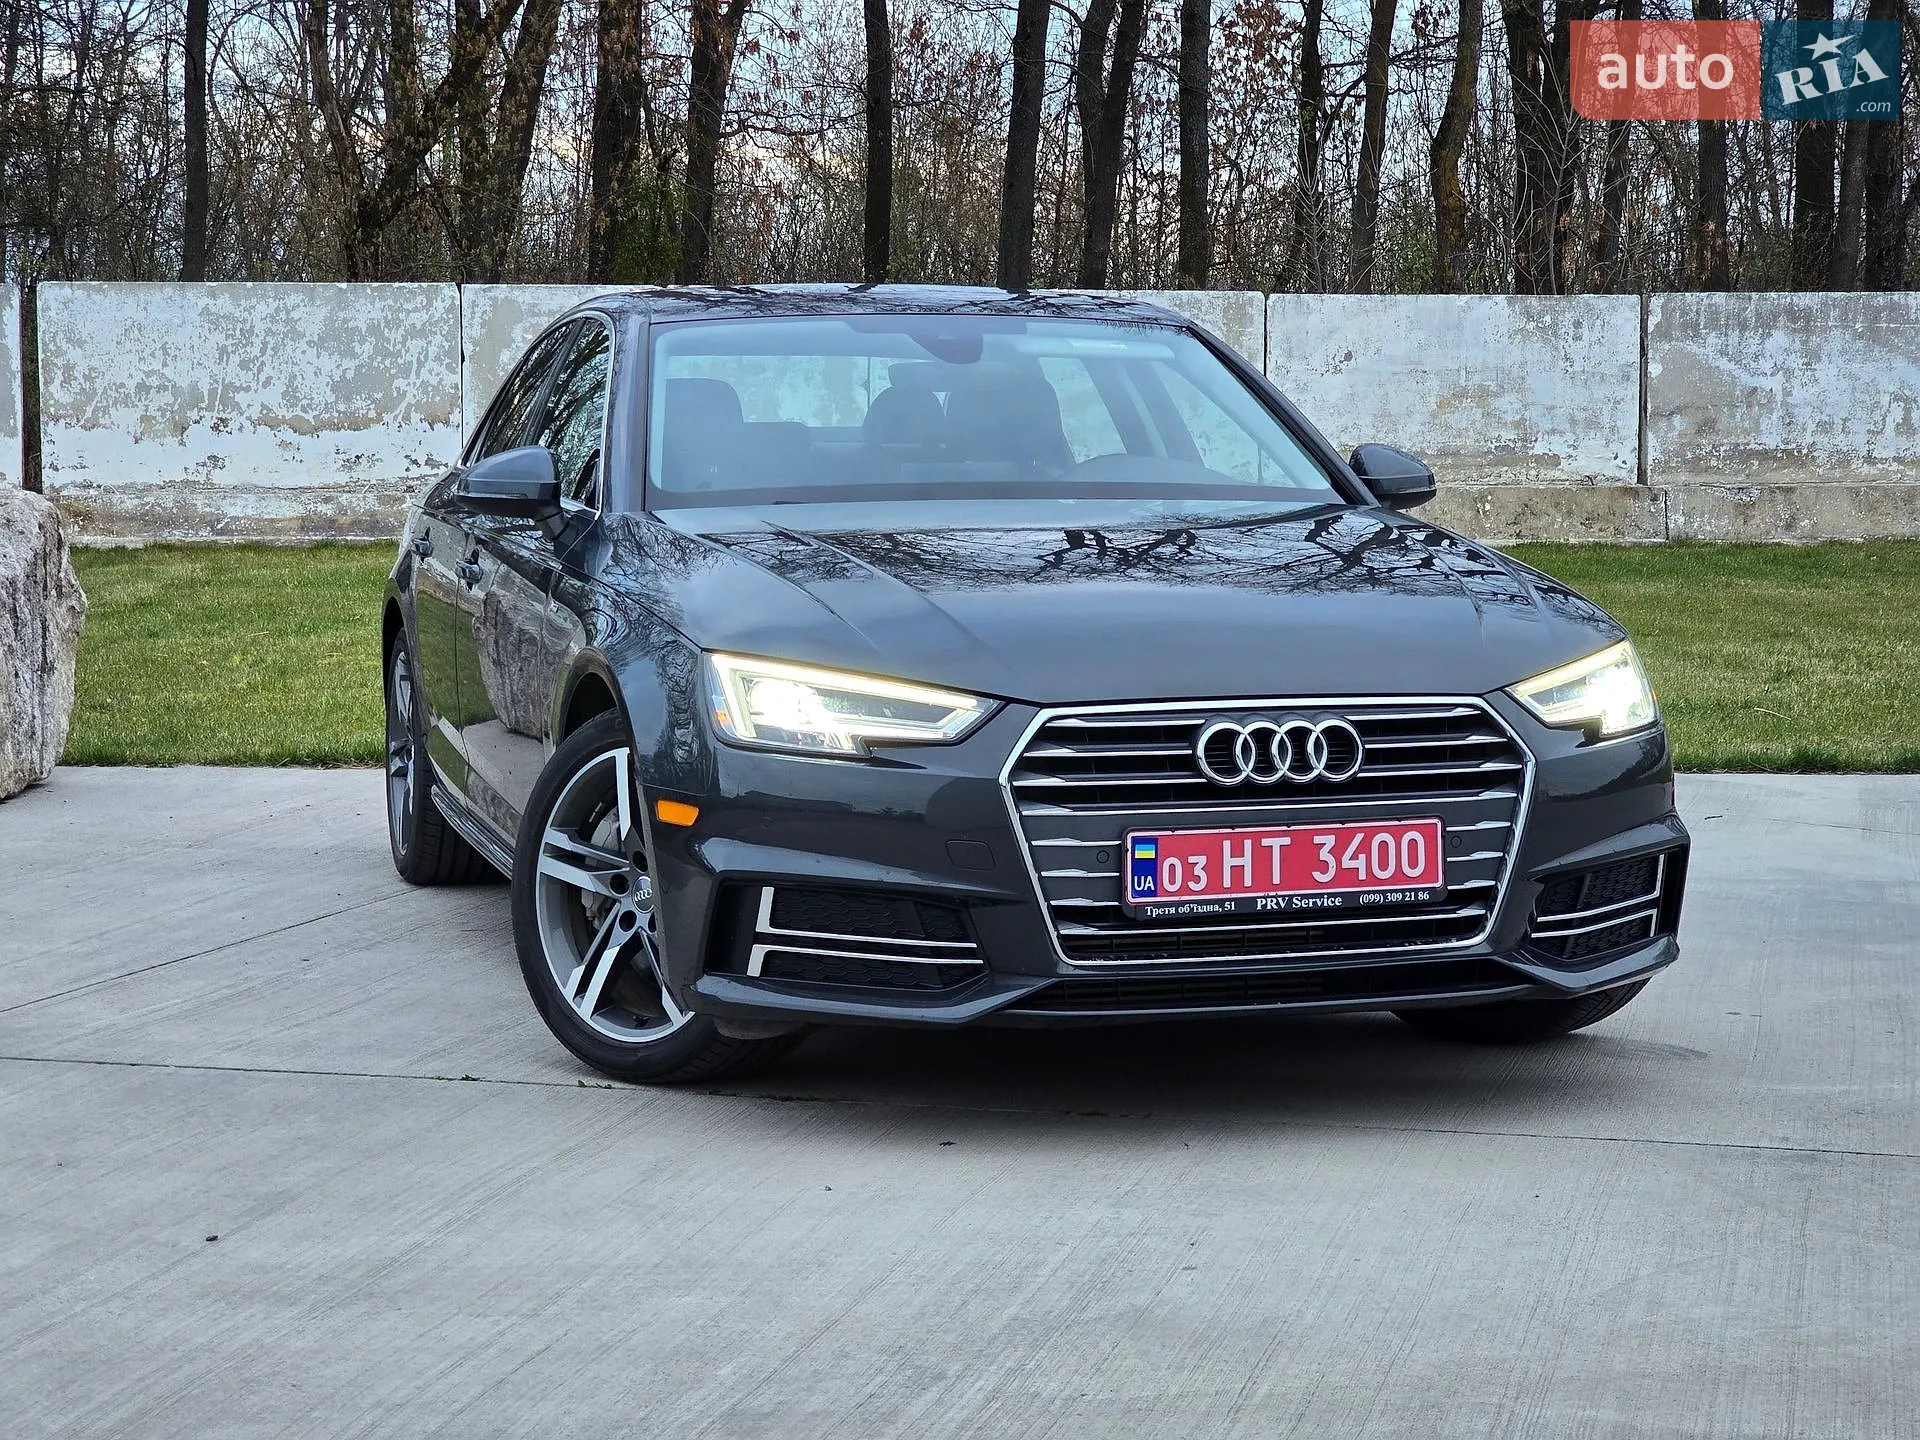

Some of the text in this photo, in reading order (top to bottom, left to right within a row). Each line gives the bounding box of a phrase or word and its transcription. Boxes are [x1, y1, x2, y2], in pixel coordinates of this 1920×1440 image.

[1161, 830, 1426, 892] 03 HT 3400
[1134, 875, 1155, 891] UA
[1256, 895, 1343, 910] PRV Service
[1359, 890, 1430, 905] (099) 309 21 86
[1224, 901, 1236, 911] 51
